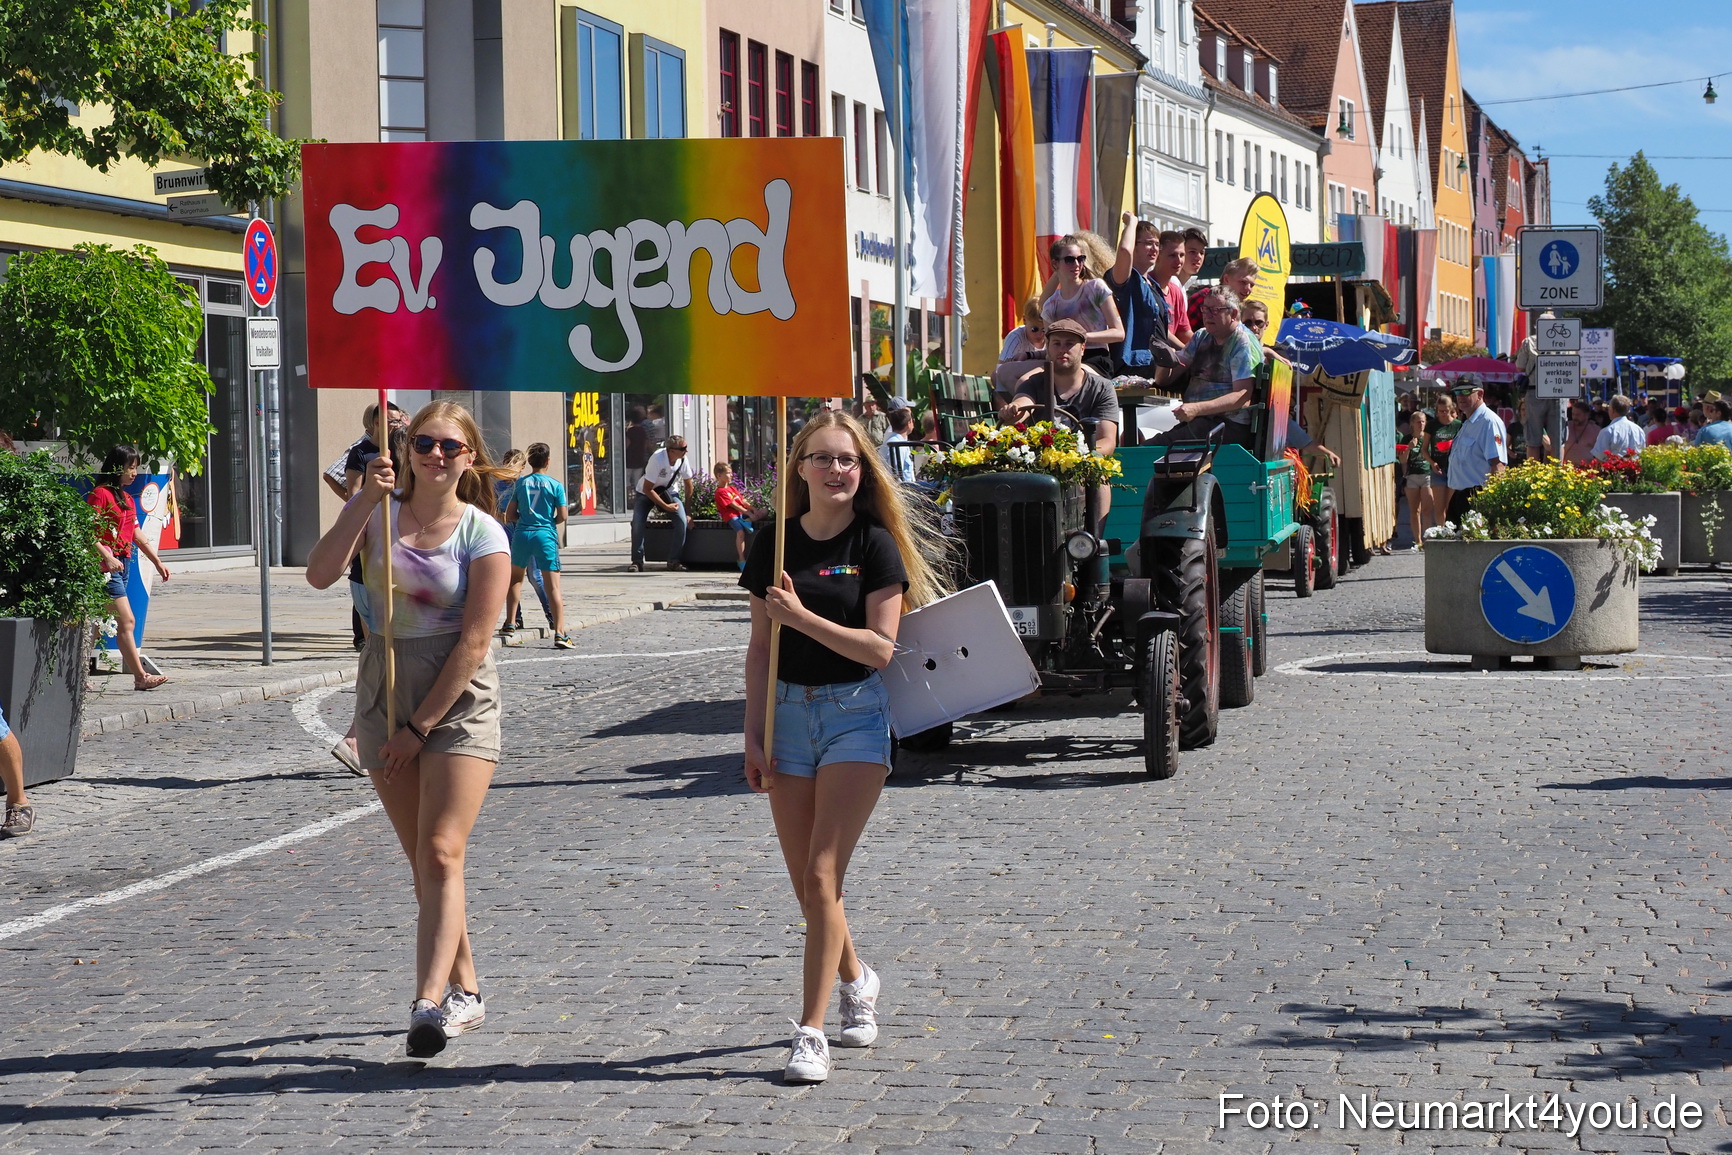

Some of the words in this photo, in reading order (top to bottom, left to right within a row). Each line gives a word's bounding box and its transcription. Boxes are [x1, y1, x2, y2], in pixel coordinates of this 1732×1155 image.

[328, 203, 443, 315] Ev.
[469, 178, 797, 372] Jugend
[1540, 287, 1579, 299] ZONE
[1540, 359, 1578, 367] Lieferverkehr
[1546, 369, 1572, 377] werktags
[573, 392, 600, 428] SALE
[528, 489, 541, 515] 7
